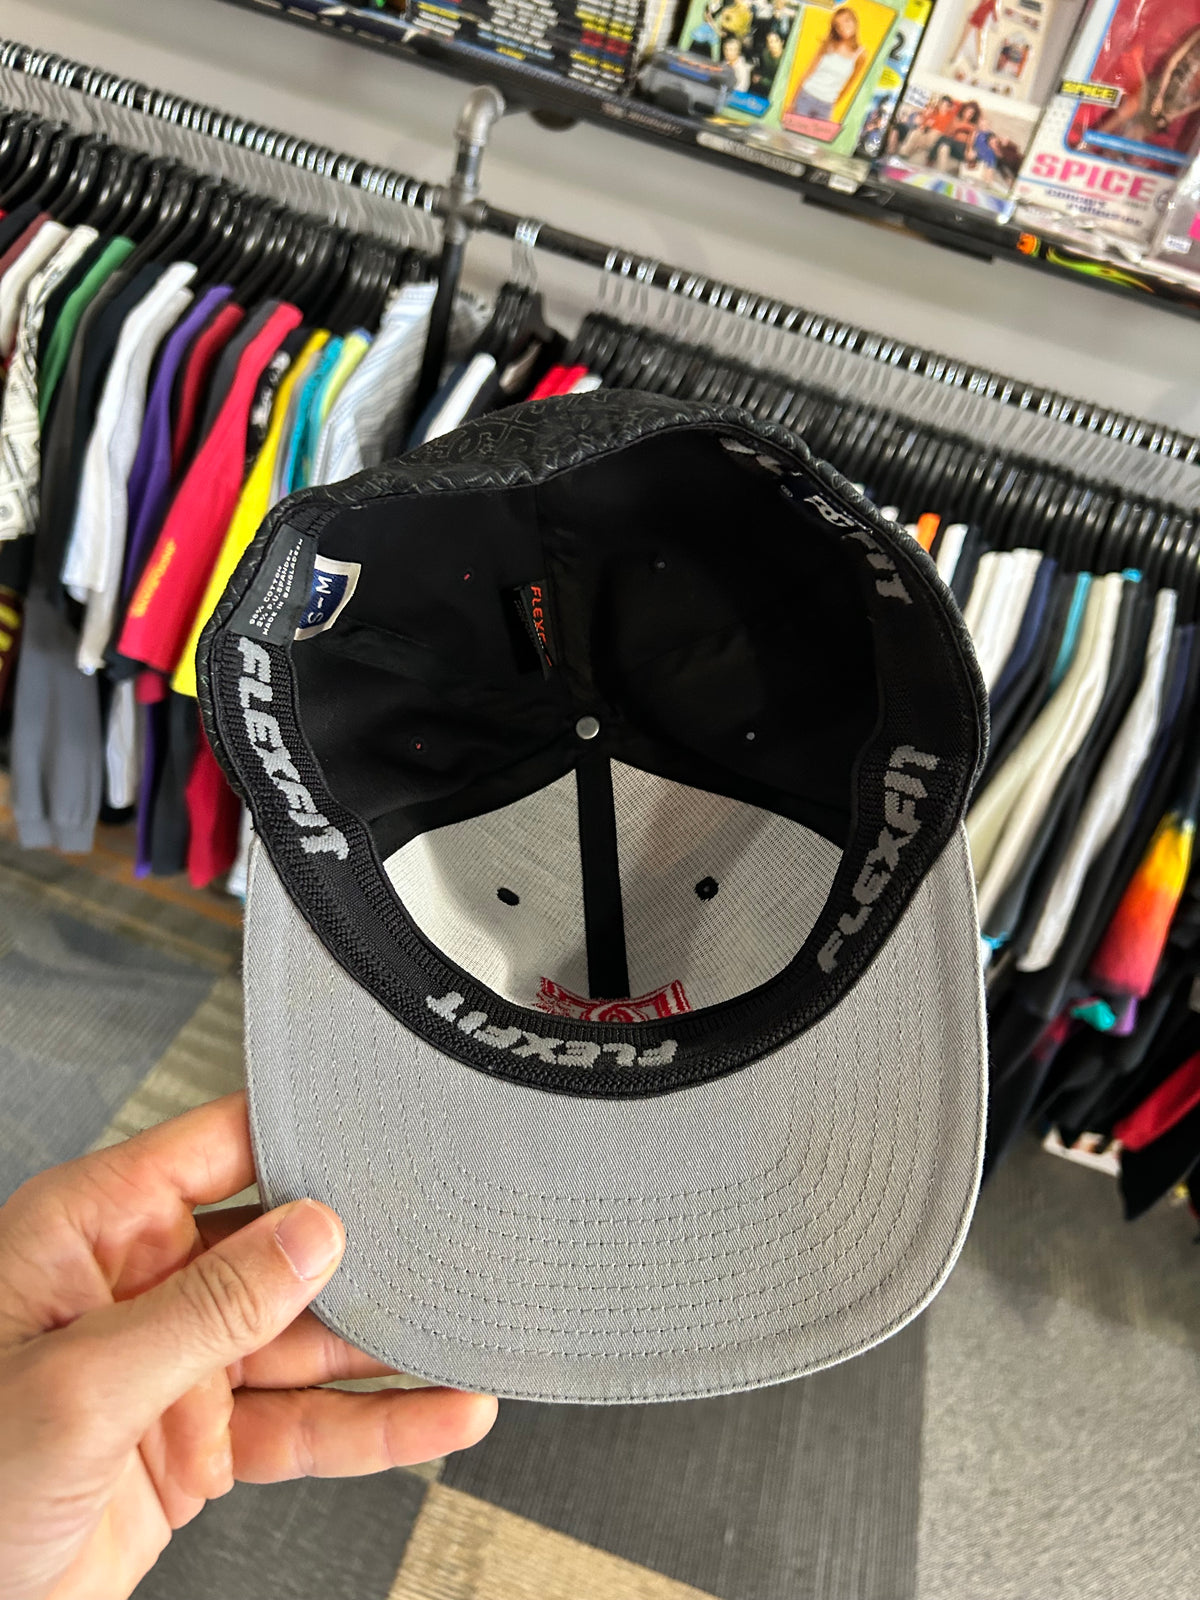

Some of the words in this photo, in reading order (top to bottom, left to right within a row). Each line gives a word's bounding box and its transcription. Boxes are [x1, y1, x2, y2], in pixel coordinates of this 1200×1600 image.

[1031, 152, 1158, 203] SPICE
[262, 611, 278, 636] MADE
[276, 601, 285, 610] IN
[263, 565, 282, 603] COTTON
[530, 586, 552, 667] FLEX
[238, 636, 350, 861] FLEXFIT
[816, 744, 940, 974] FLEXFIT
[425, 991, 678, 1068] FLEXFIT
